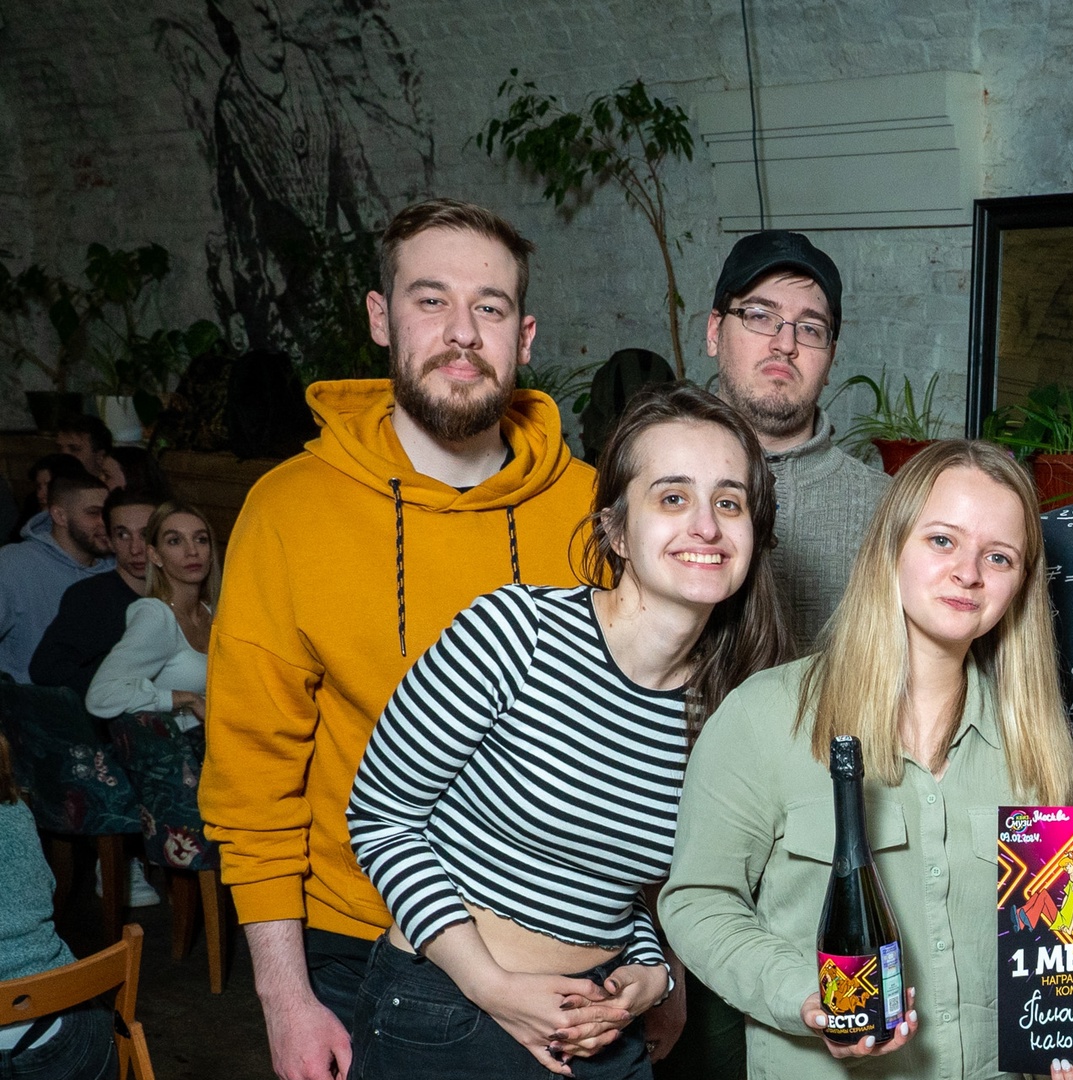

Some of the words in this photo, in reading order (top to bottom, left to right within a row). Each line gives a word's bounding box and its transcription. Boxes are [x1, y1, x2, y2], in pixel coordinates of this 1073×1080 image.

[1005, 816, 1032, 829] Смузи
[1032, 809, 1070, 823] Москва
[1012, 948, 1029, 977] 1
[827, 1013, 869, 1028] ЕСТО
